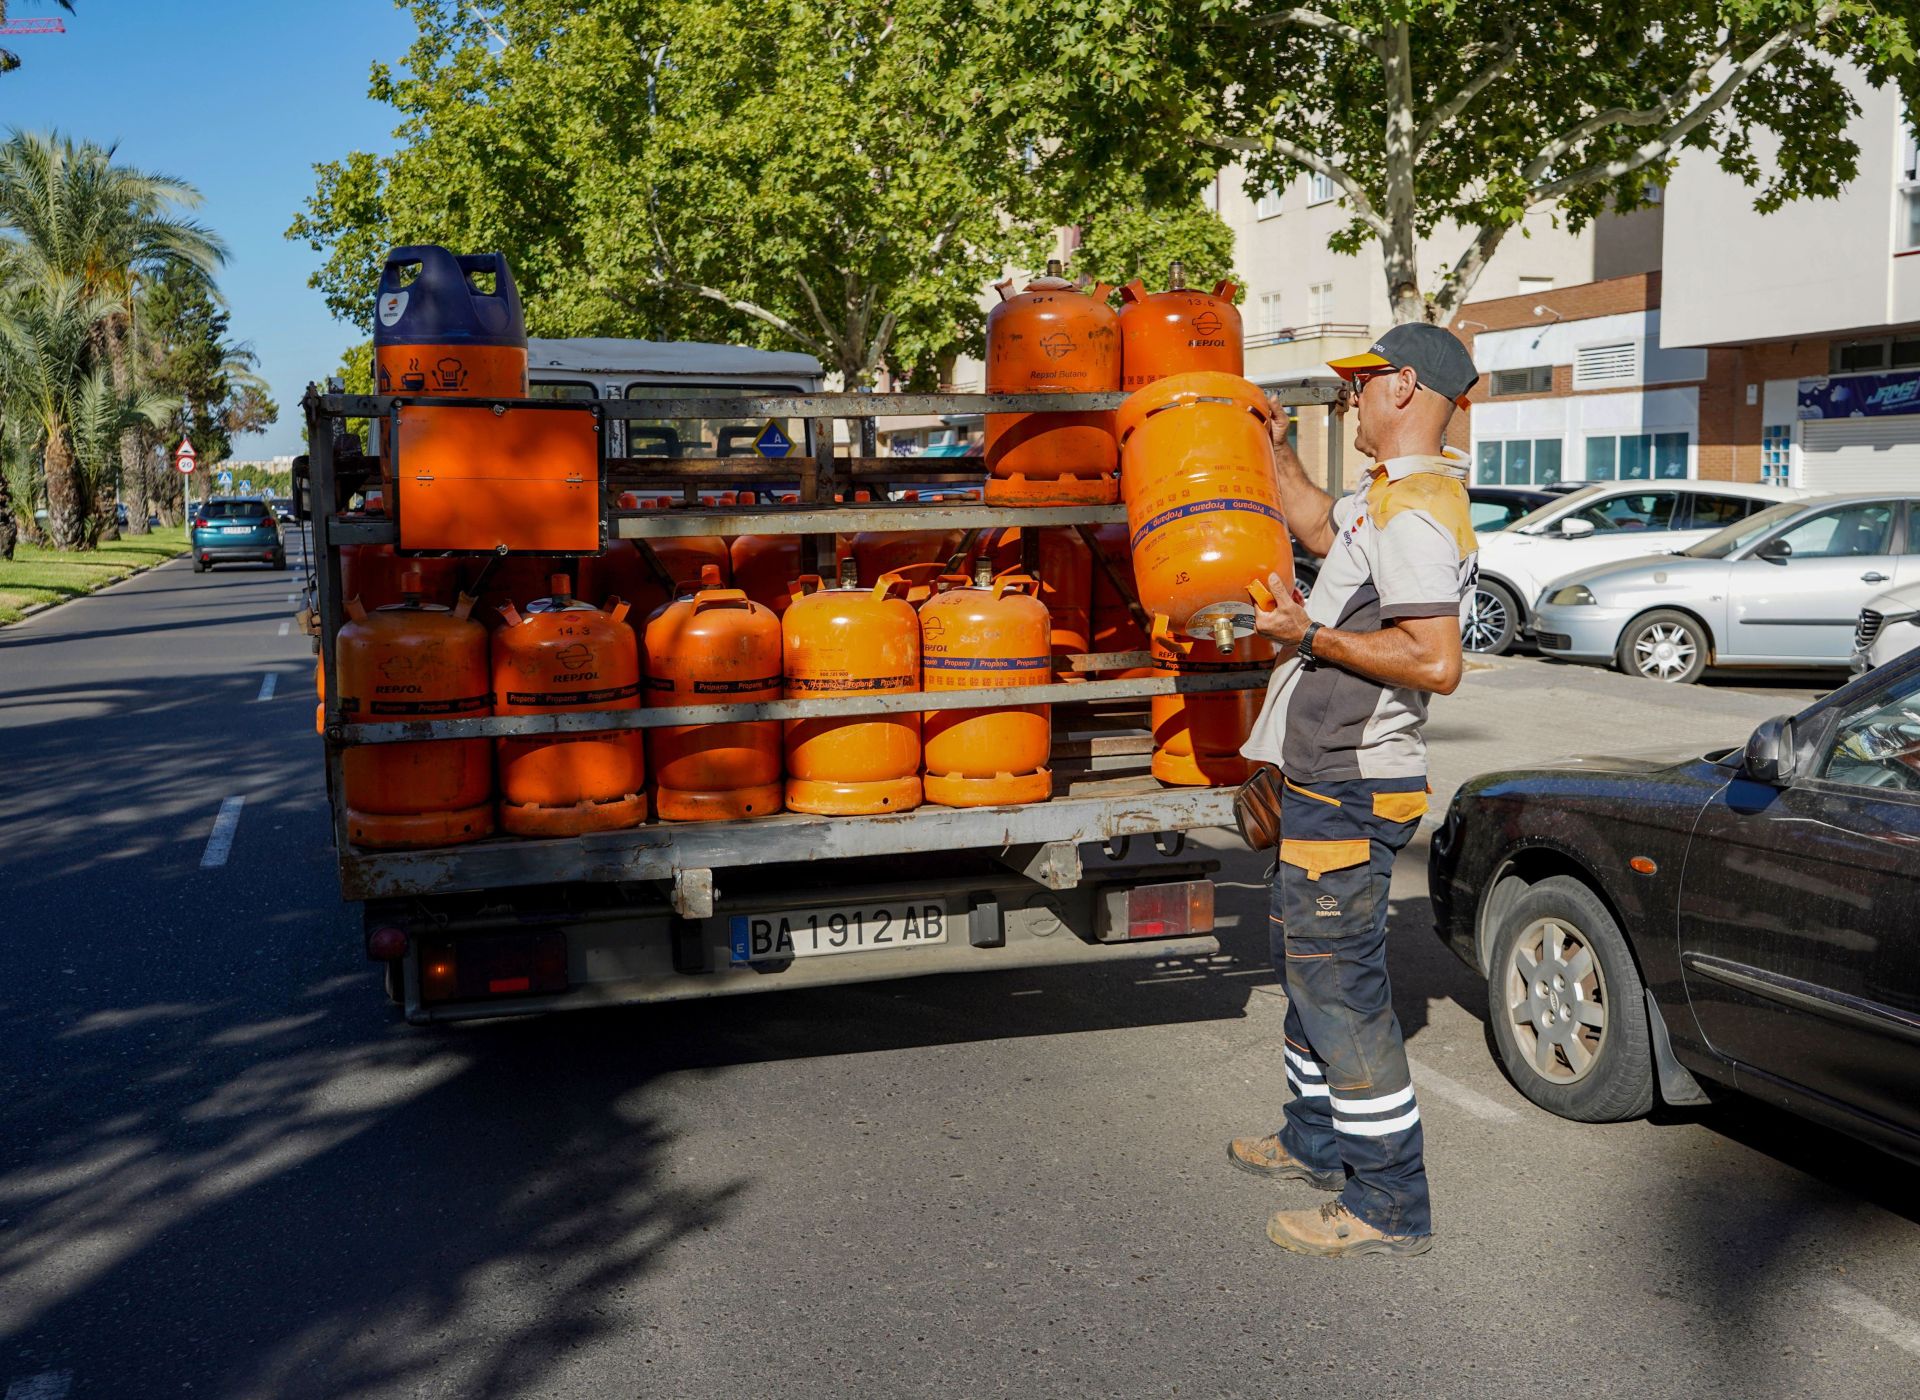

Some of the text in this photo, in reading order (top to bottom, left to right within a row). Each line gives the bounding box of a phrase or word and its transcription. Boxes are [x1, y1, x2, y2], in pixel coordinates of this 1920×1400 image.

[1030, 370, 1087, 379] Repsol Butano
[774, 433, 782, 443] A
[1190, 501, 1226, 513] Propano
[1233, 501, 1265, 513] Propano
[1152, 509, 1183, 528] Propano
[558, 627, 591, 636] 14.3
[944, 659, 970, 667] Propano
[980, 660, 1008, 668] Propano
[552, 671, 600, 683] REPSOL
[375, 685, 424, 694] REPSOL
[698, 683, 729, 691] Propano
[510, 694, 536, 703] Propano
[546, 694, 577, 704] Propano
[751, 904, 943, 955] BA 1912 AB
[736, 942, 745, 954] E
